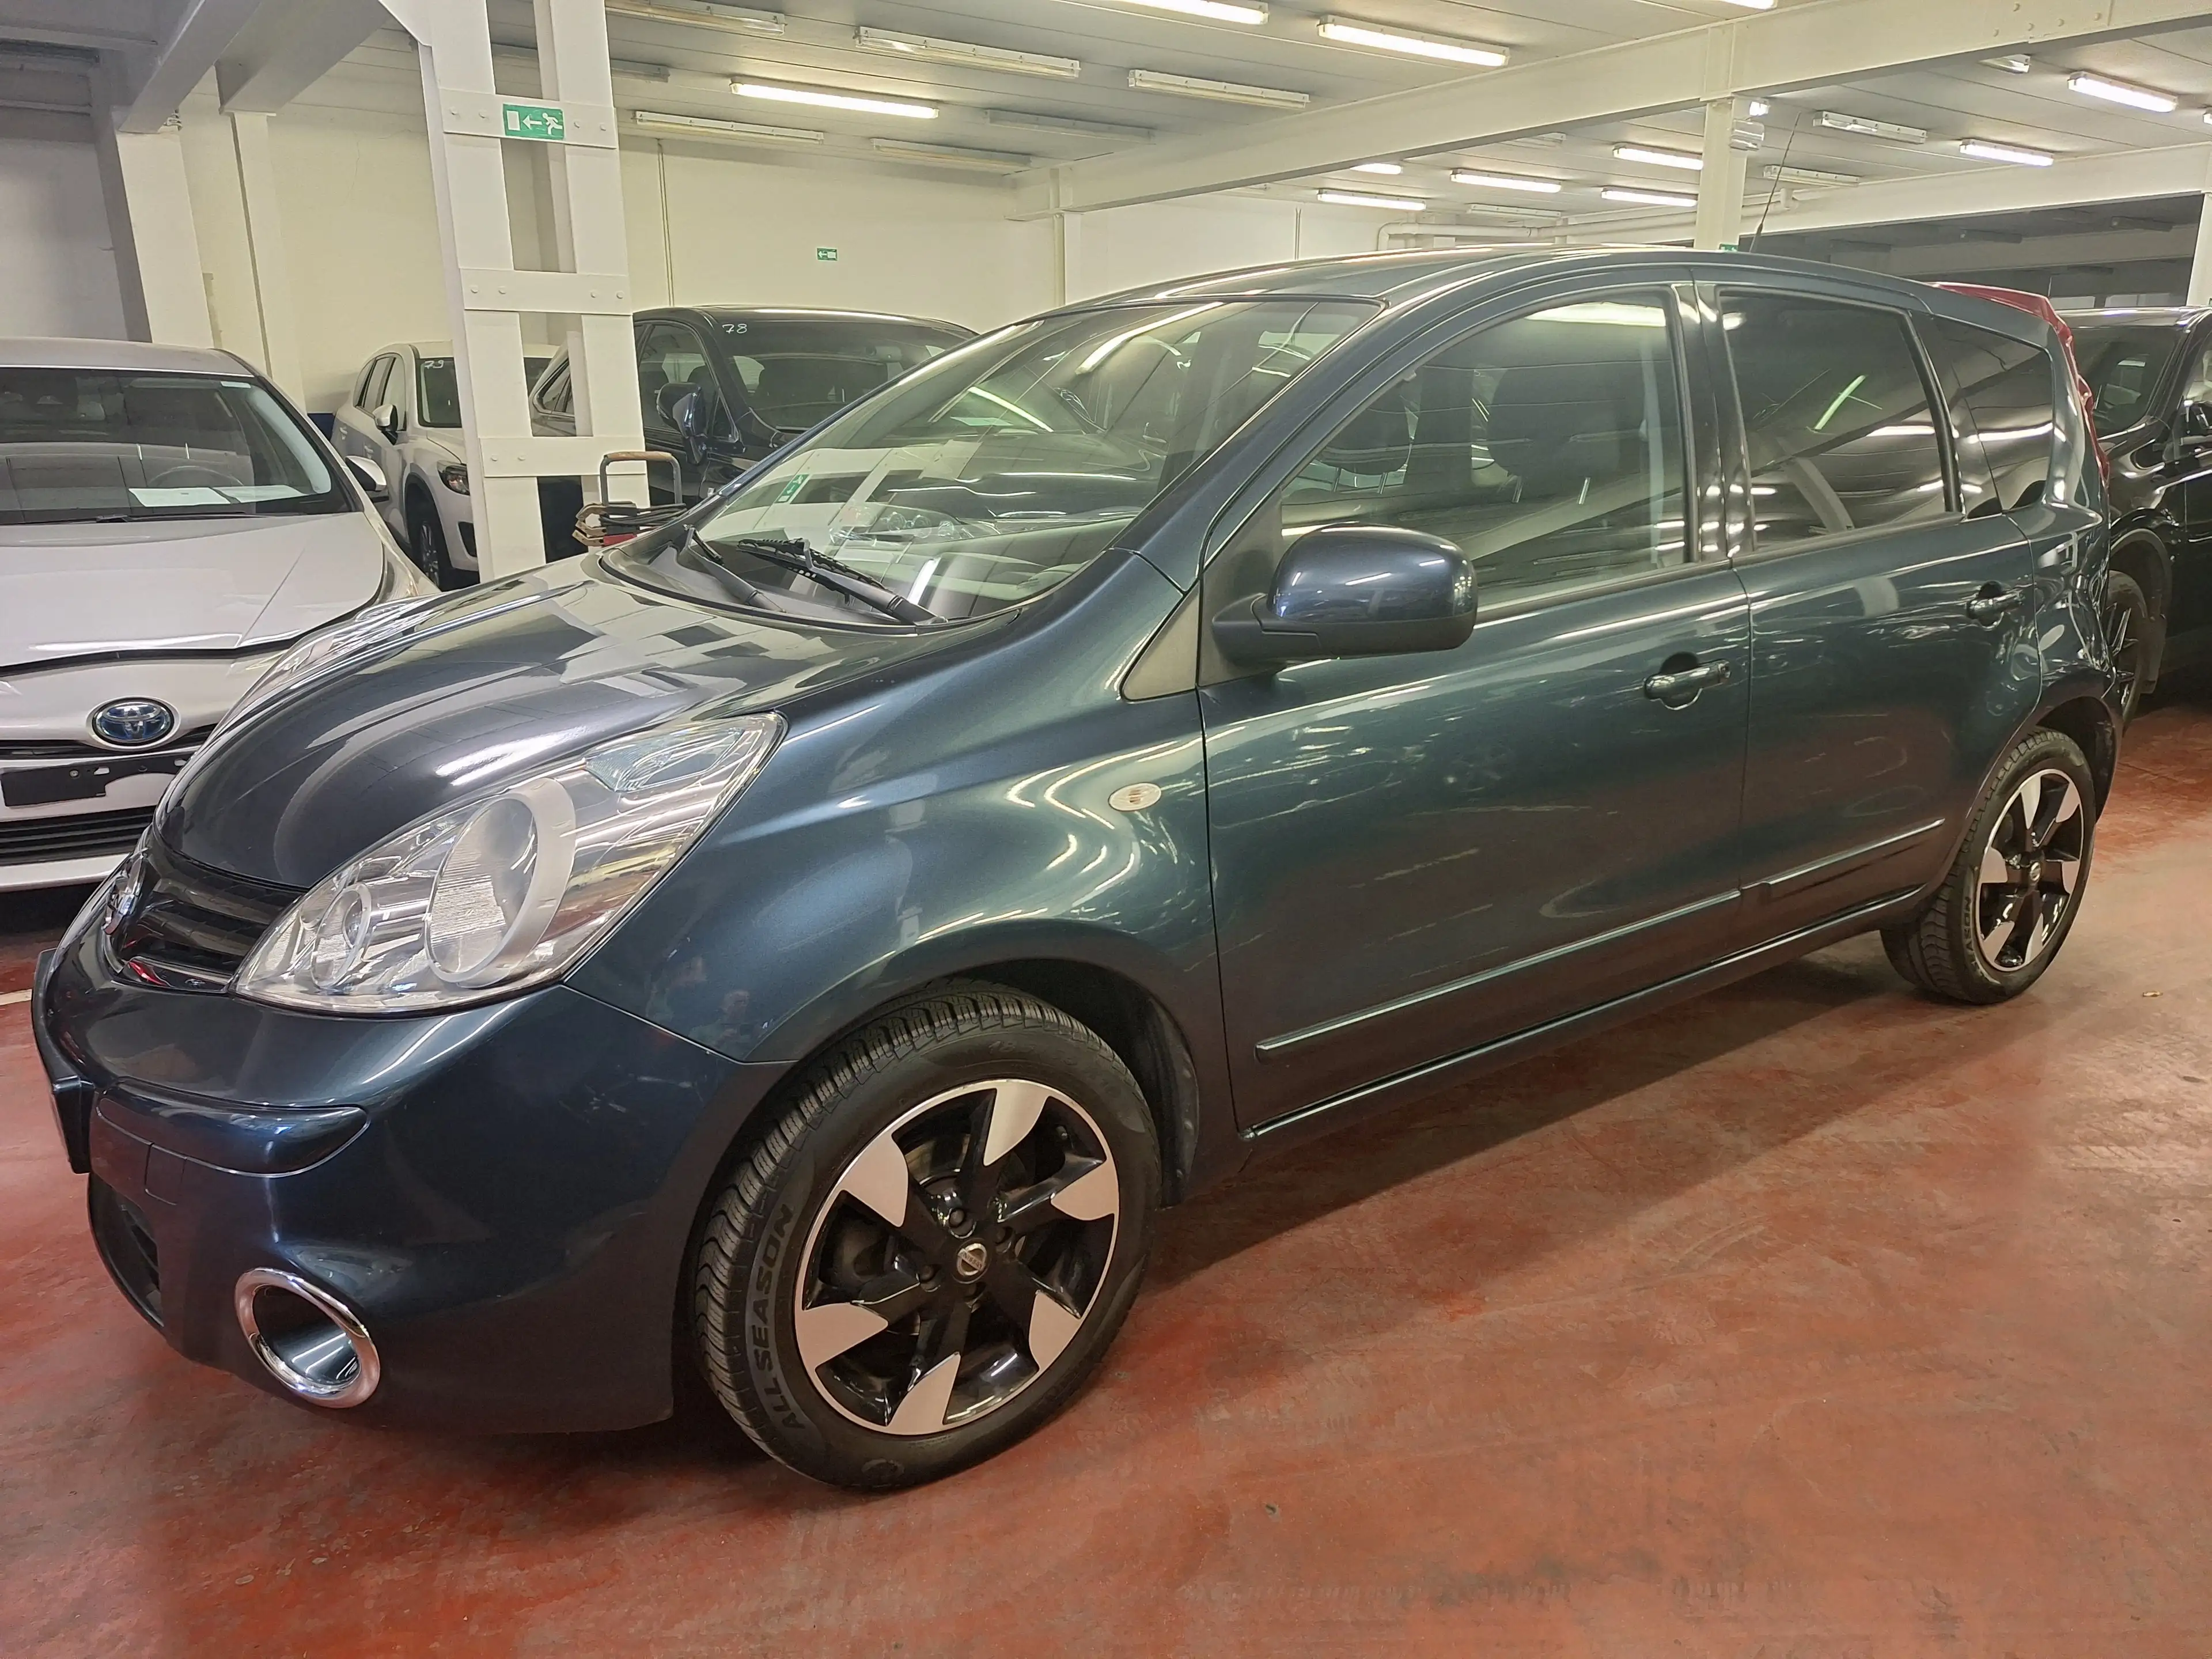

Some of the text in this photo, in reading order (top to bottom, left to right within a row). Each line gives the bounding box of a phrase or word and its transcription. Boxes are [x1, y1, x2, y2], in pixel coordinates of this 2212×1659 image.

[722, 323, 747, 334] 78
[424, 359, 444, 369] 79
[752, 1203, 806, 1430] ALL SEASON
